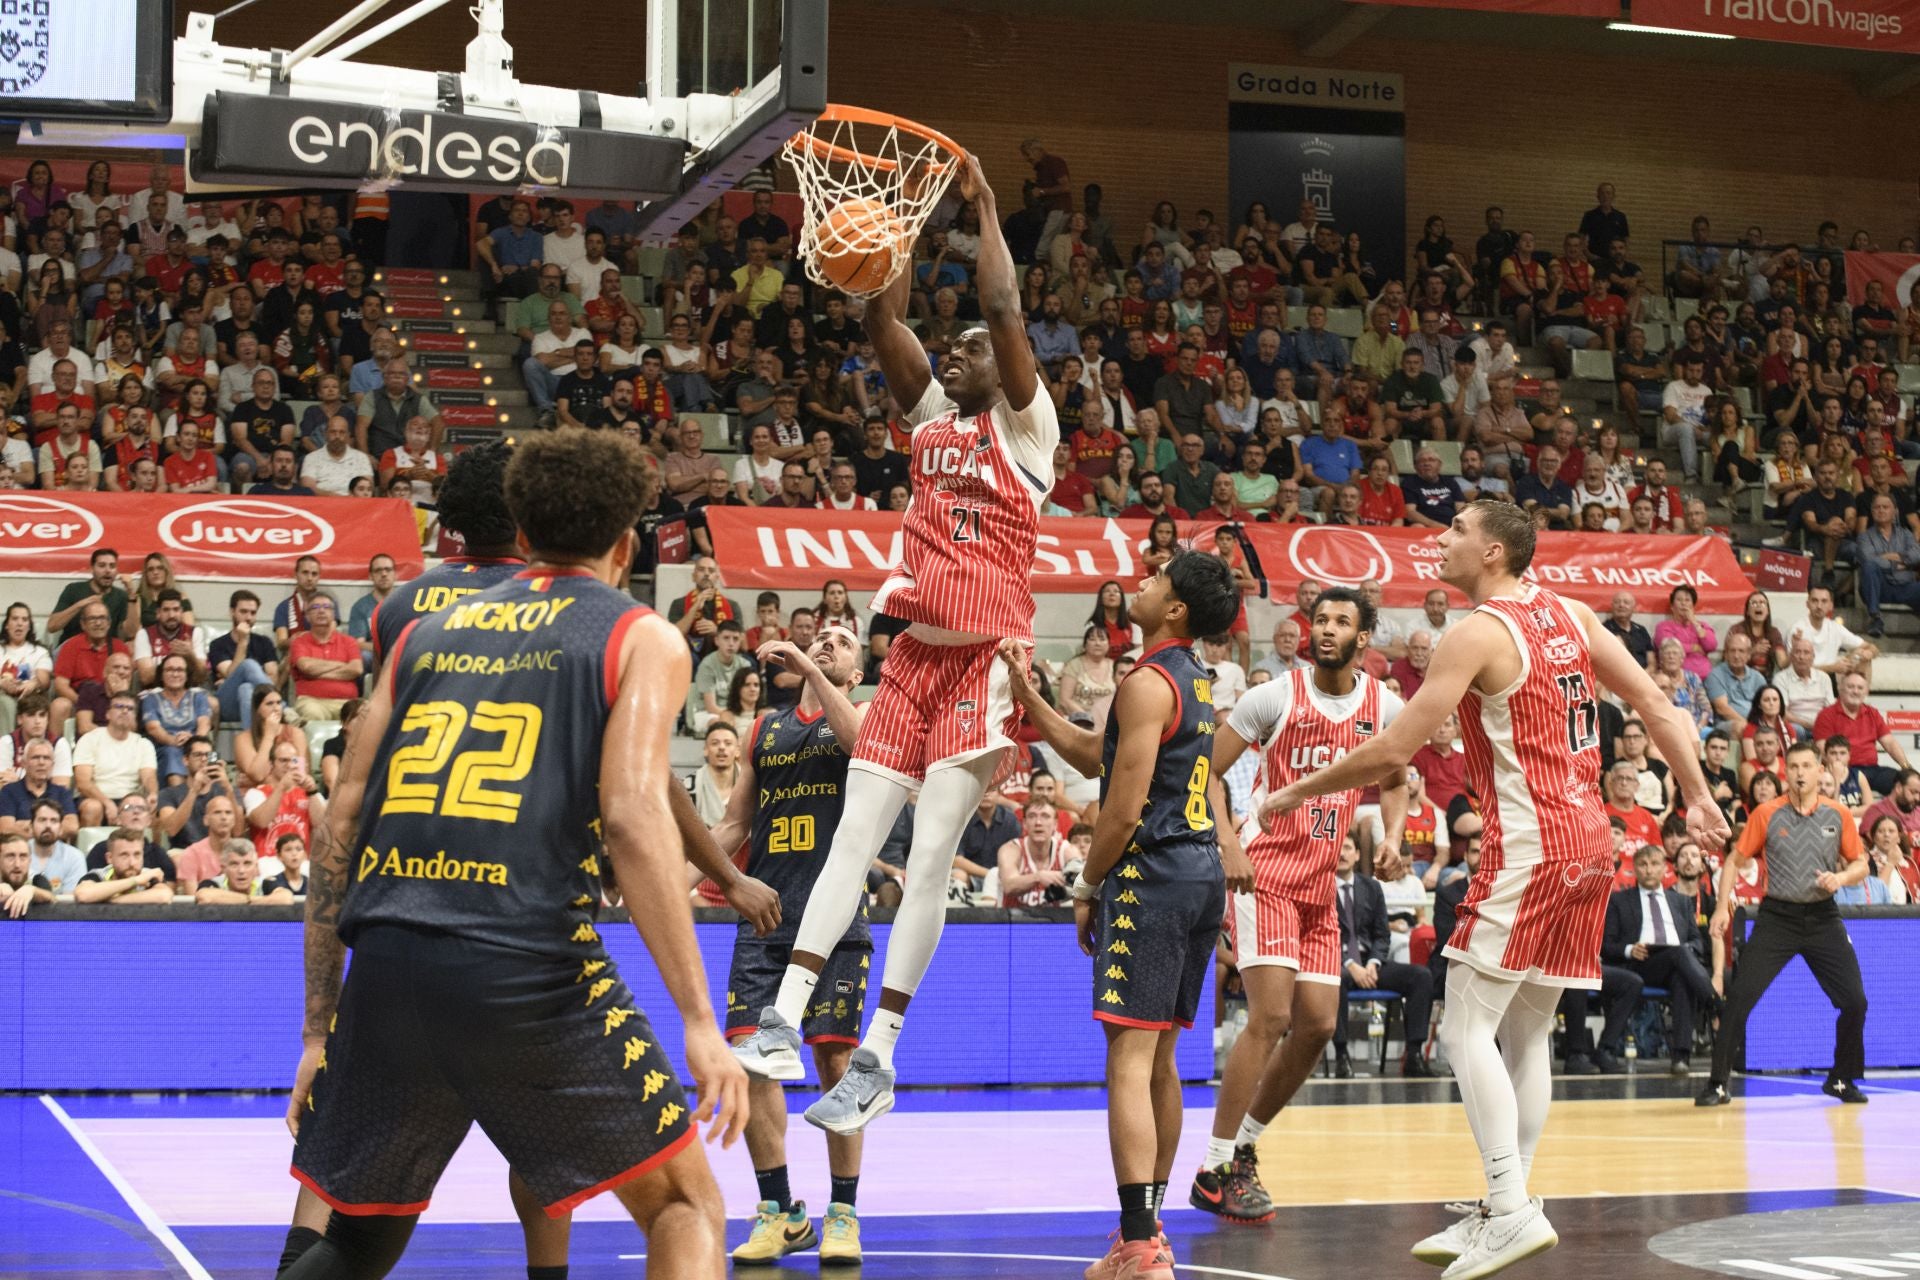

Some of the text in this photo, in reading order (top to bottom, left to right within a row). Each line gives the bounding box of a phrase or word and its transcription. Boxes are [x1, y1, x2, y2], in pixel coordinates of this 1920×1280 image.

[1237, 72, 1396, 101] Grada Norte
[288, 113, 571, 187] endesa
[0, 521, 82, 540] ver
[181, 519, 313, 546] Juver
[951, 507, 981, 542] 21
[1407, 543, 1441, 559] Cos
[1543, 565, 1583, 584] DE
[1594, 567, 1720, 588] MURCIA
[1764, 562, 1803, 579] MÓDULO
[413, 586, 484, 613] UDE
[443, 596, 576, 633] MCKOY
[434, 649, 563, 676] MORABANC
[380, 699, 543, 824] 22
[1290, 745, 1351, 770] UCA
[771, 780, 838, 805] Andorra
[1184, 755, 1214, 832] 8
[768, 814, 816, 854] 20
[1310, 808, 1337, 840] 24
[379, 846, 509, 887] Andorra
